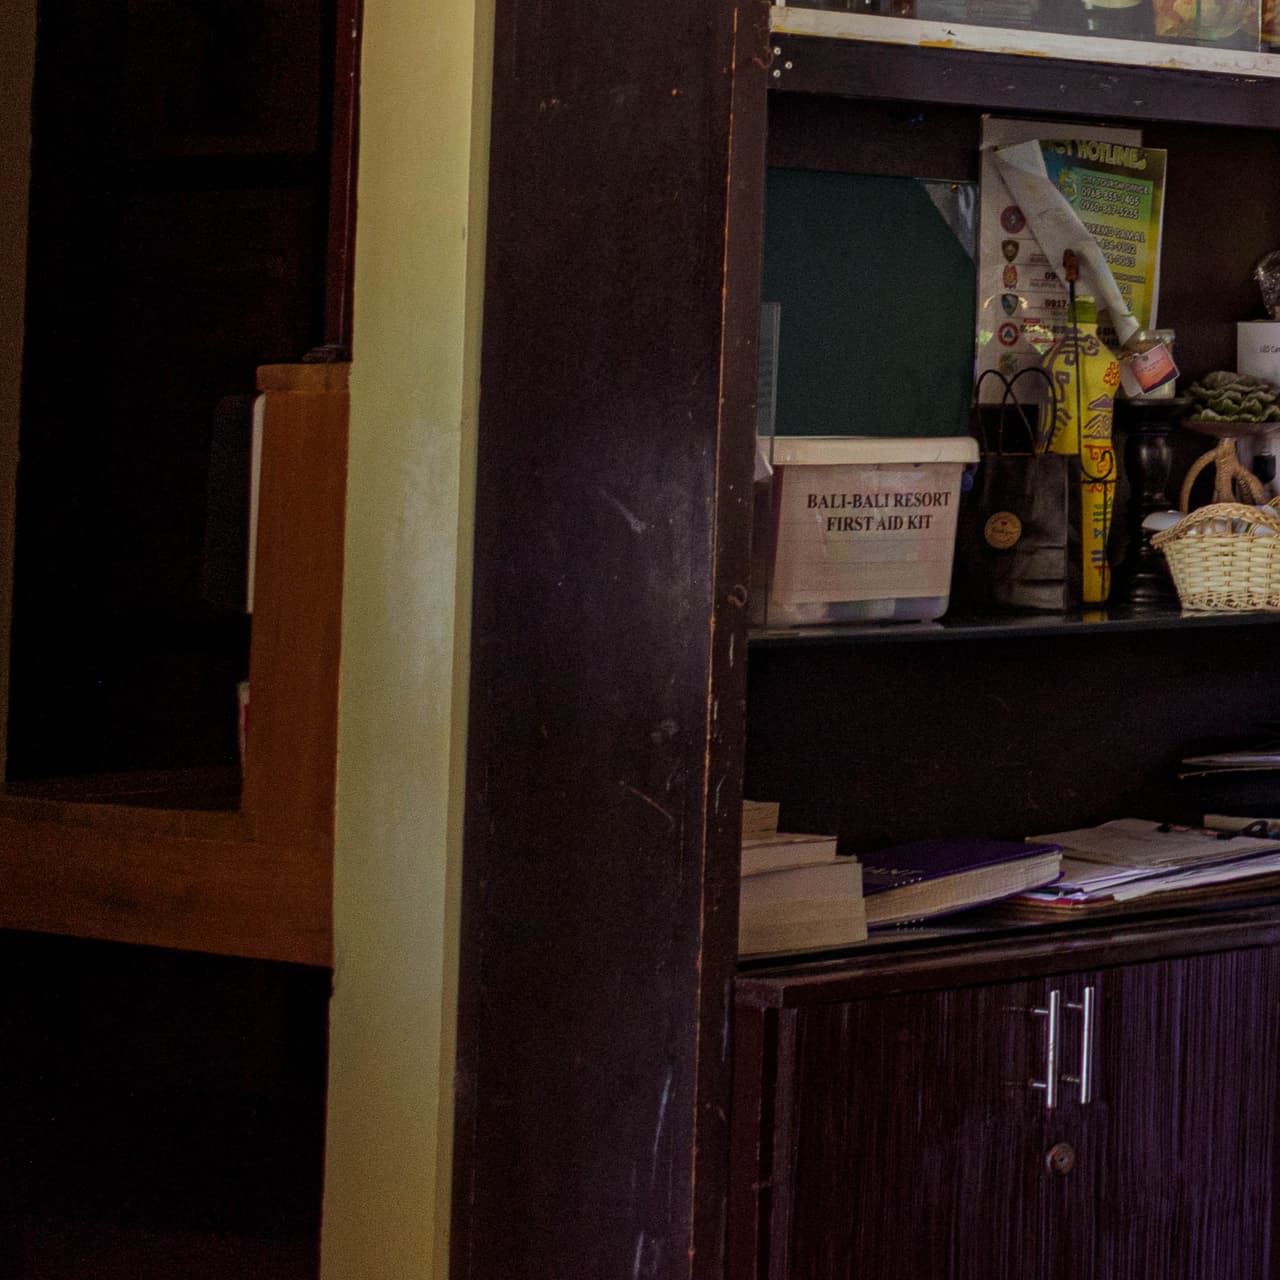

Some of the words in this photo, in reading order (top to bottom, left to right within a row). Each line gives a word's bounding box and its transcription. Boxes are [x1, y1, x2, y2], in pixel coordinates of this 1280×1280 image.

[807, 493, 889, 509] BALI-BALI
[893, 491, 951, 508] RESORT
[826, 516, 874, 532] FIRST
[875, 516, 904, 530] AID
[906, 514, 933, 530] KIT
